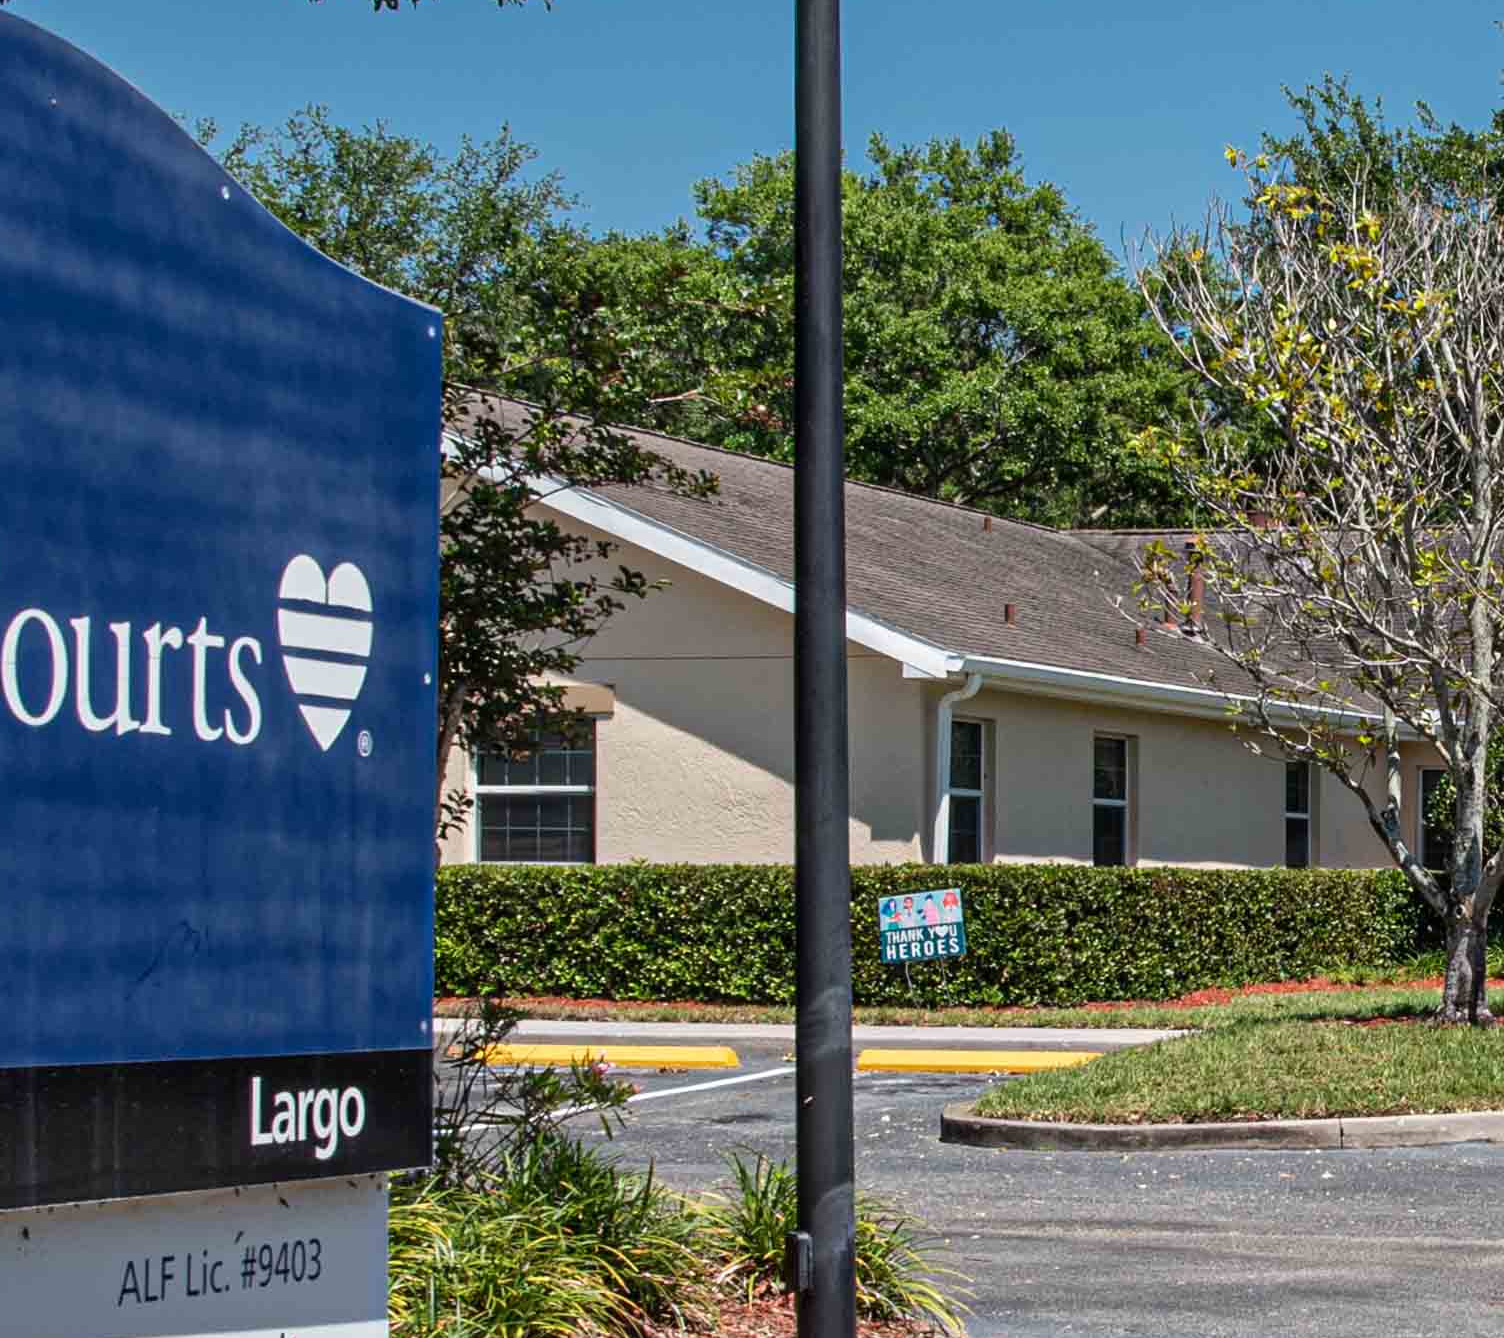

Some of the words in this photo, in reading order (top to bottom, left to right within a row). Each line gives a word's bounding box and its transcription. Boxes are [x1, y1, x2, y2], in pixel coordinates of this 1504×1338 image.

[886, 927, 925, 945] THANK
[886, 937, 960, 959] HEROES
[250, 1075, 365, 1161] Largo
[118, 1256, 175, 1307] ALF
[186, 1250, 230, 1296] Lic.
[240, 1238, 322, 1290] #9403
